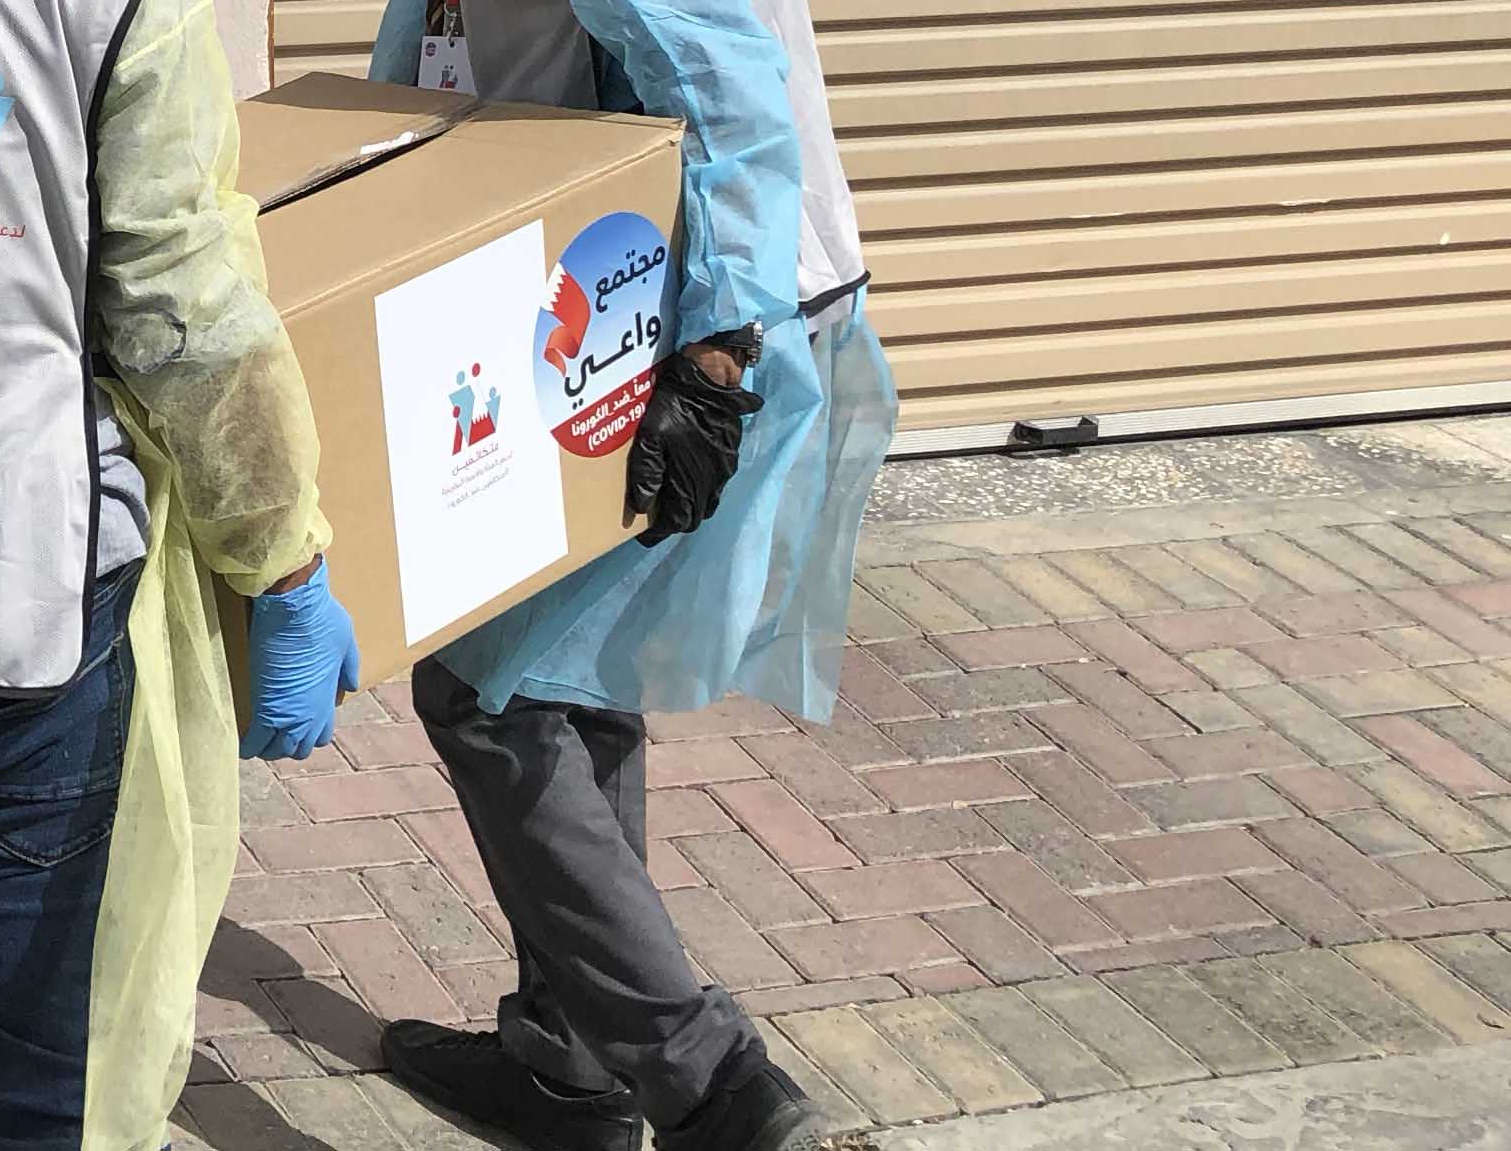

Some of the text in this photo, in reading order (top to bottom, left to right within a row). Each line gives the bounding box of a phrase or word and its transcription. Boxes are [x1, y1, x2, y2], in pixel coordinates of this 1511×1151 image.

[595, 245, 666, 313] مجتمع
[564, 311, 662, 410] واعي
[588, 401, 646, 451] (COVID-19)
